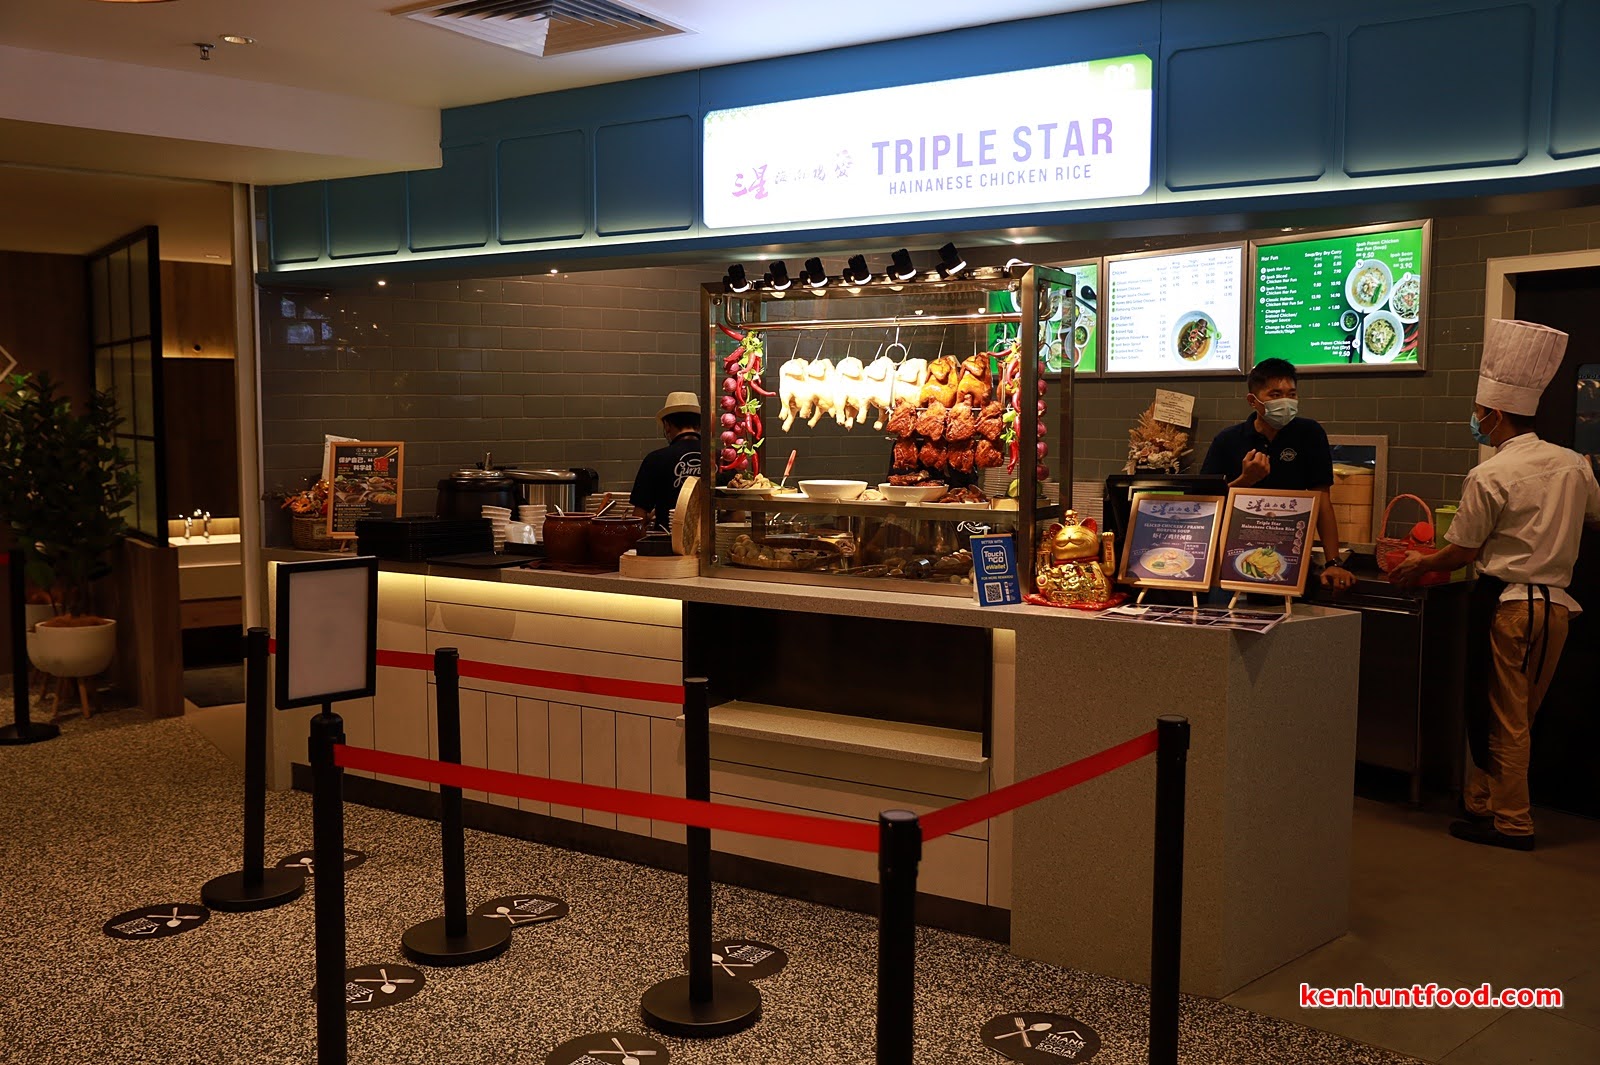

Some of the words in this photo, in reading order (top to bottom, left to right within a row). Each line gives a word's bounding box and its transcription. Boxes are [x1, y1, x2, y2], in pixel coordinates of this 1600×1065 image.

[872, 130, 996, 175] TRIPLE
[1013, 118, 1112, 162] STAR
[889, 175, 973, 195] HAINANESE
[980, 168, 1047, 187] CHICKEN
[1056, 164, 1092, 180] RICE
[1040, 1042, 1076, 1056] SOCIAL
[1048, 1033, 1086, 1047] THANK
